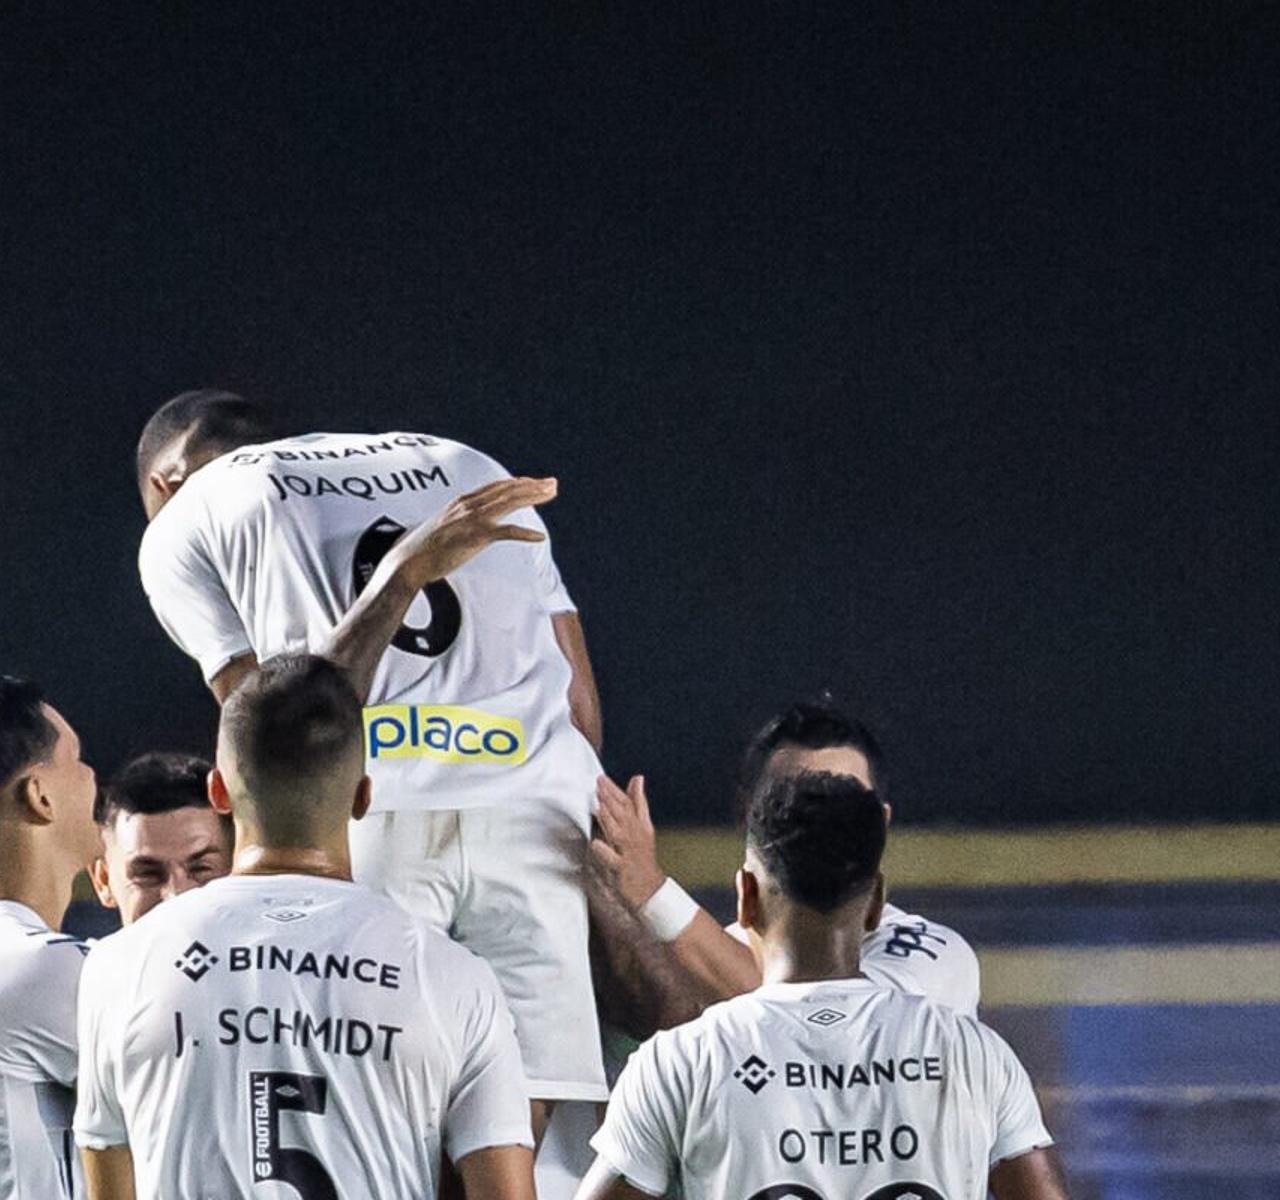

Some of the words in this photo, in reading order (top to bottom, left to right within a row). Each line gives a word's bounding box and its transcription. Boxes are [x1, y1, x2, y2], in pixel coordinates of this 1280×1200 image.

[270, 434, 440, 462] BINANCE
[268, 465, 451, 501] JOAQUIM
[369, 705, 519, 758] placo
[229, 944, 402, 989] BINANCE
[174, 1010, 200, 1058] J.
[218, 1006, 403, 1061] SCHMIDT
[785, 1056, 944, 1091] BINANCE
[779, 1124, 919, 1166] OTERO
